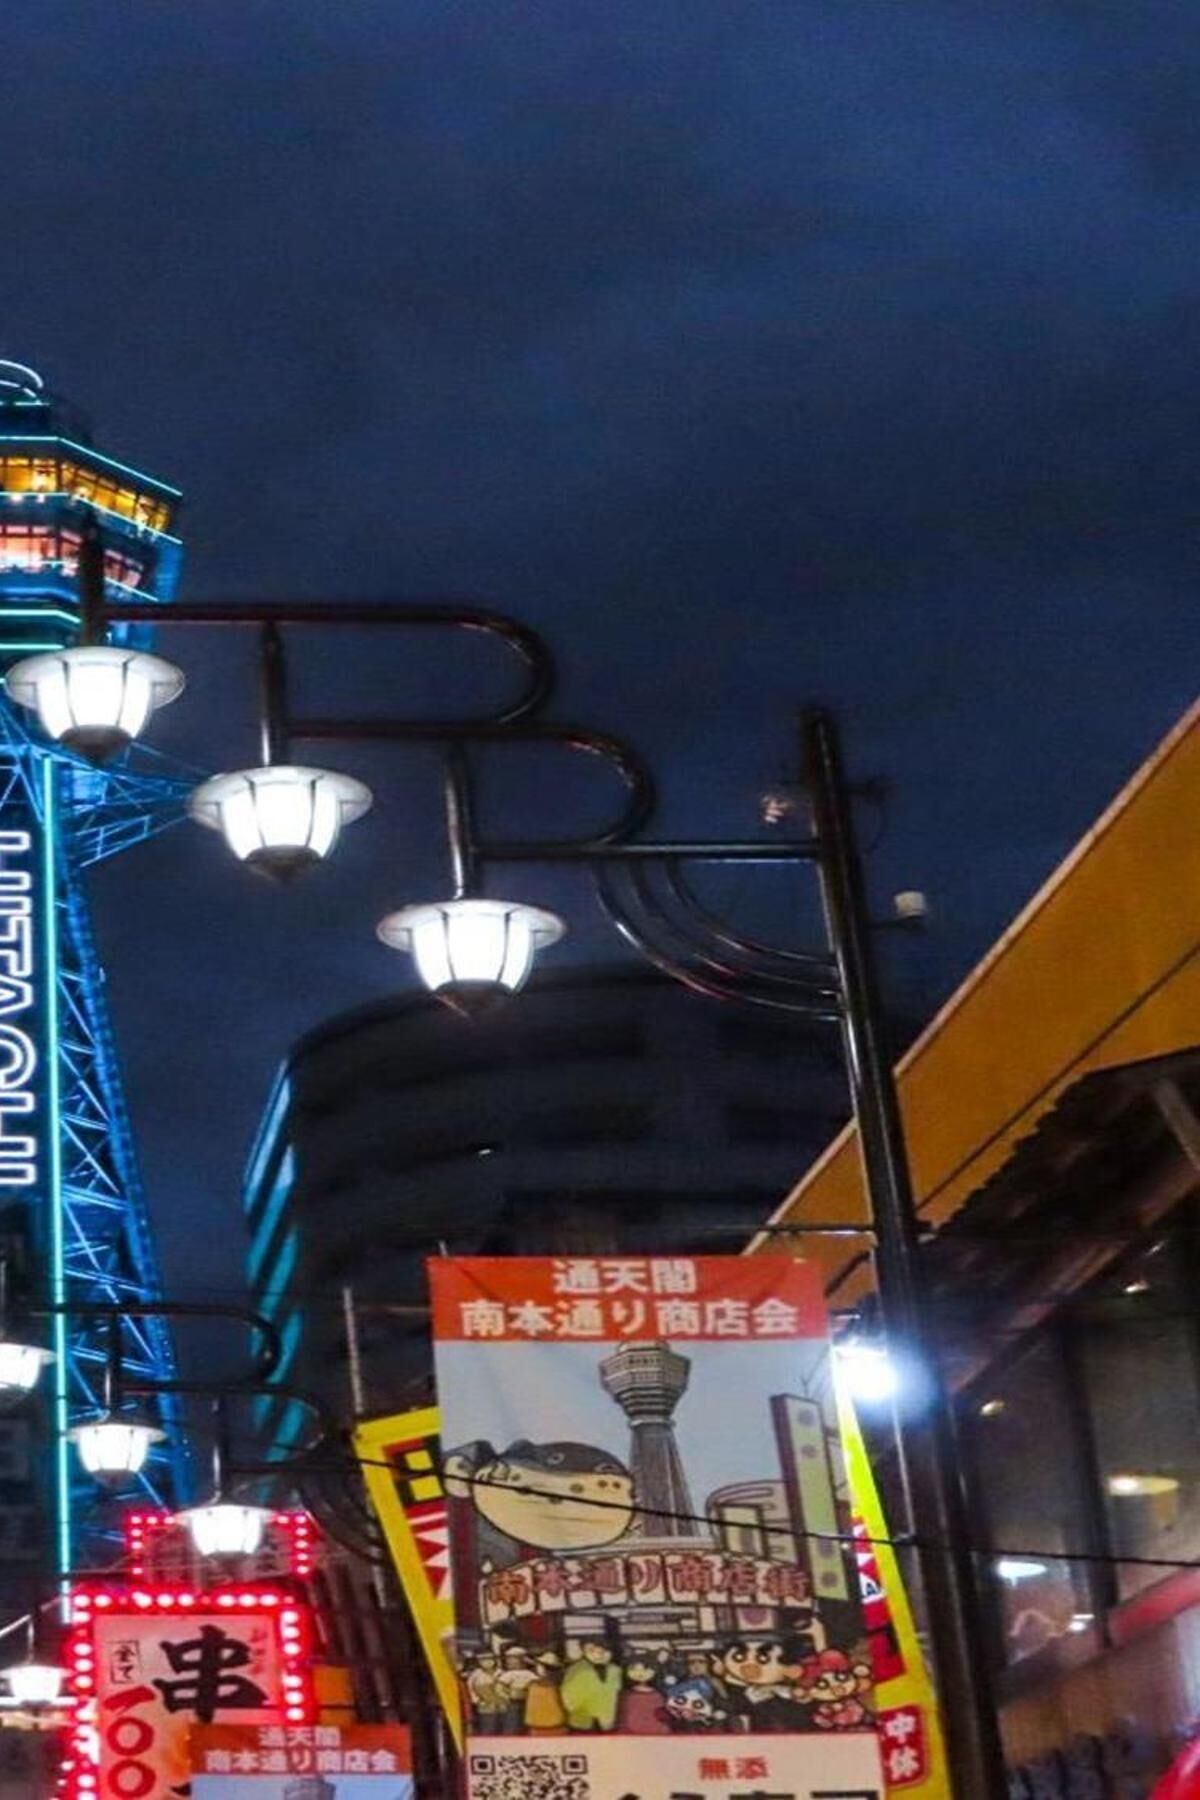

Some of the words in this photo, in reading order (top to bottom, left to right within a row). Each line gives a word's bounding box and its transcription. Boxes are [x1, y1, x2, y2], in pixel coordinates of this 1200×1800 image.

[552, 1259, 697, 1295] 通天閣
[459, 1299, 798, 1336] 南本通り商店会
[487, 1552, 810, 1606] 南本通り商店街
[152, 1624, 270, 1724] 串
